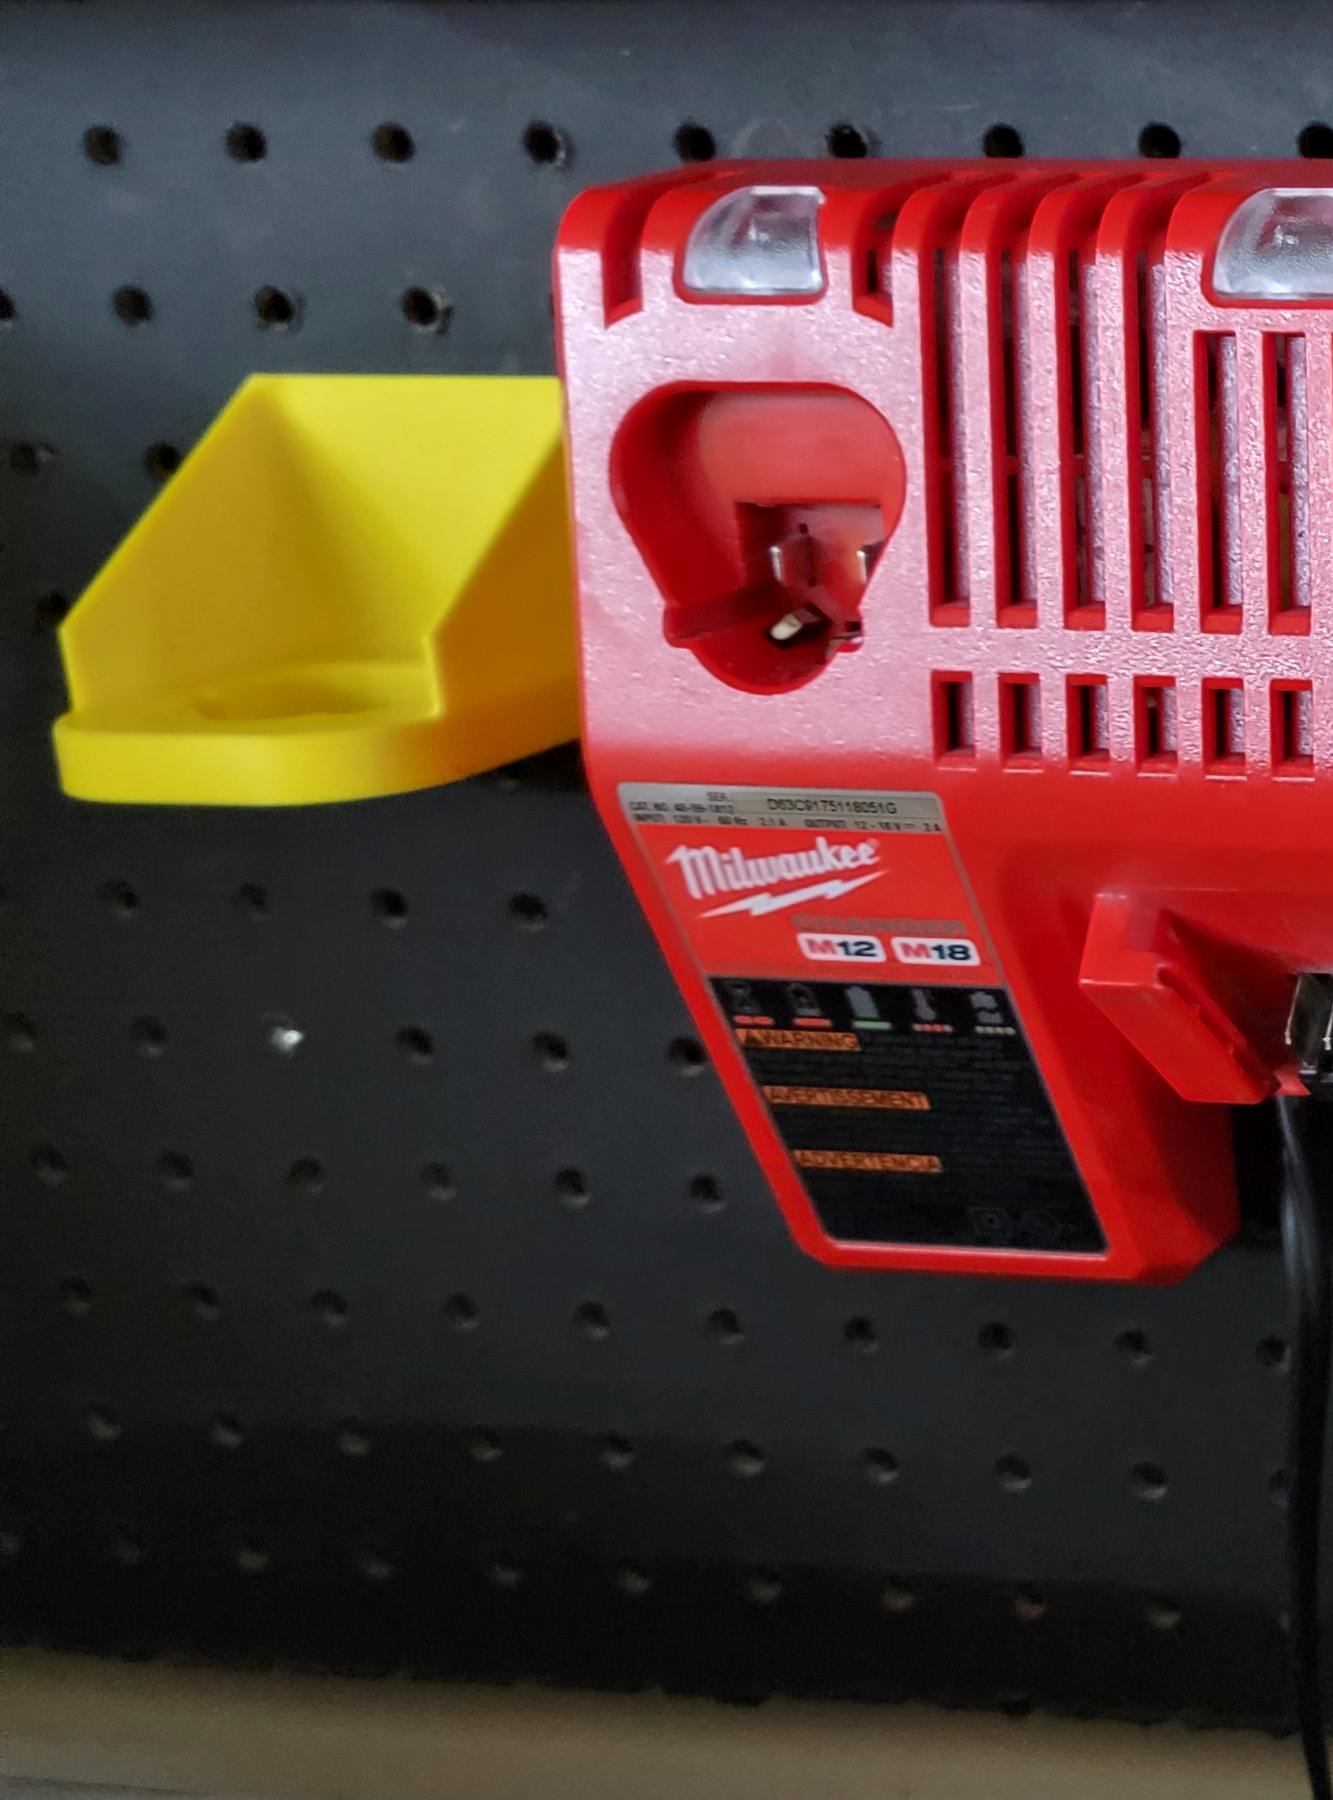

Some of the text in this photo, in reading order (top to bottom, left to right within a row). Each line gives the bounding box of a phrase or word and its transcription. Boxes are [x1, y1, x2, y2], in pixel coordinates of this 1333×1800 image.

[666, 836, 881, 900] Milwaukee
[805, 938, 973, 962] M12 M18
[766, 1031, 859, 1049] WARNING
[769, 1087, 928, 1109] AVERTISSEMENT
[800, 1151, 942, 1172] ADVERTENCIA
